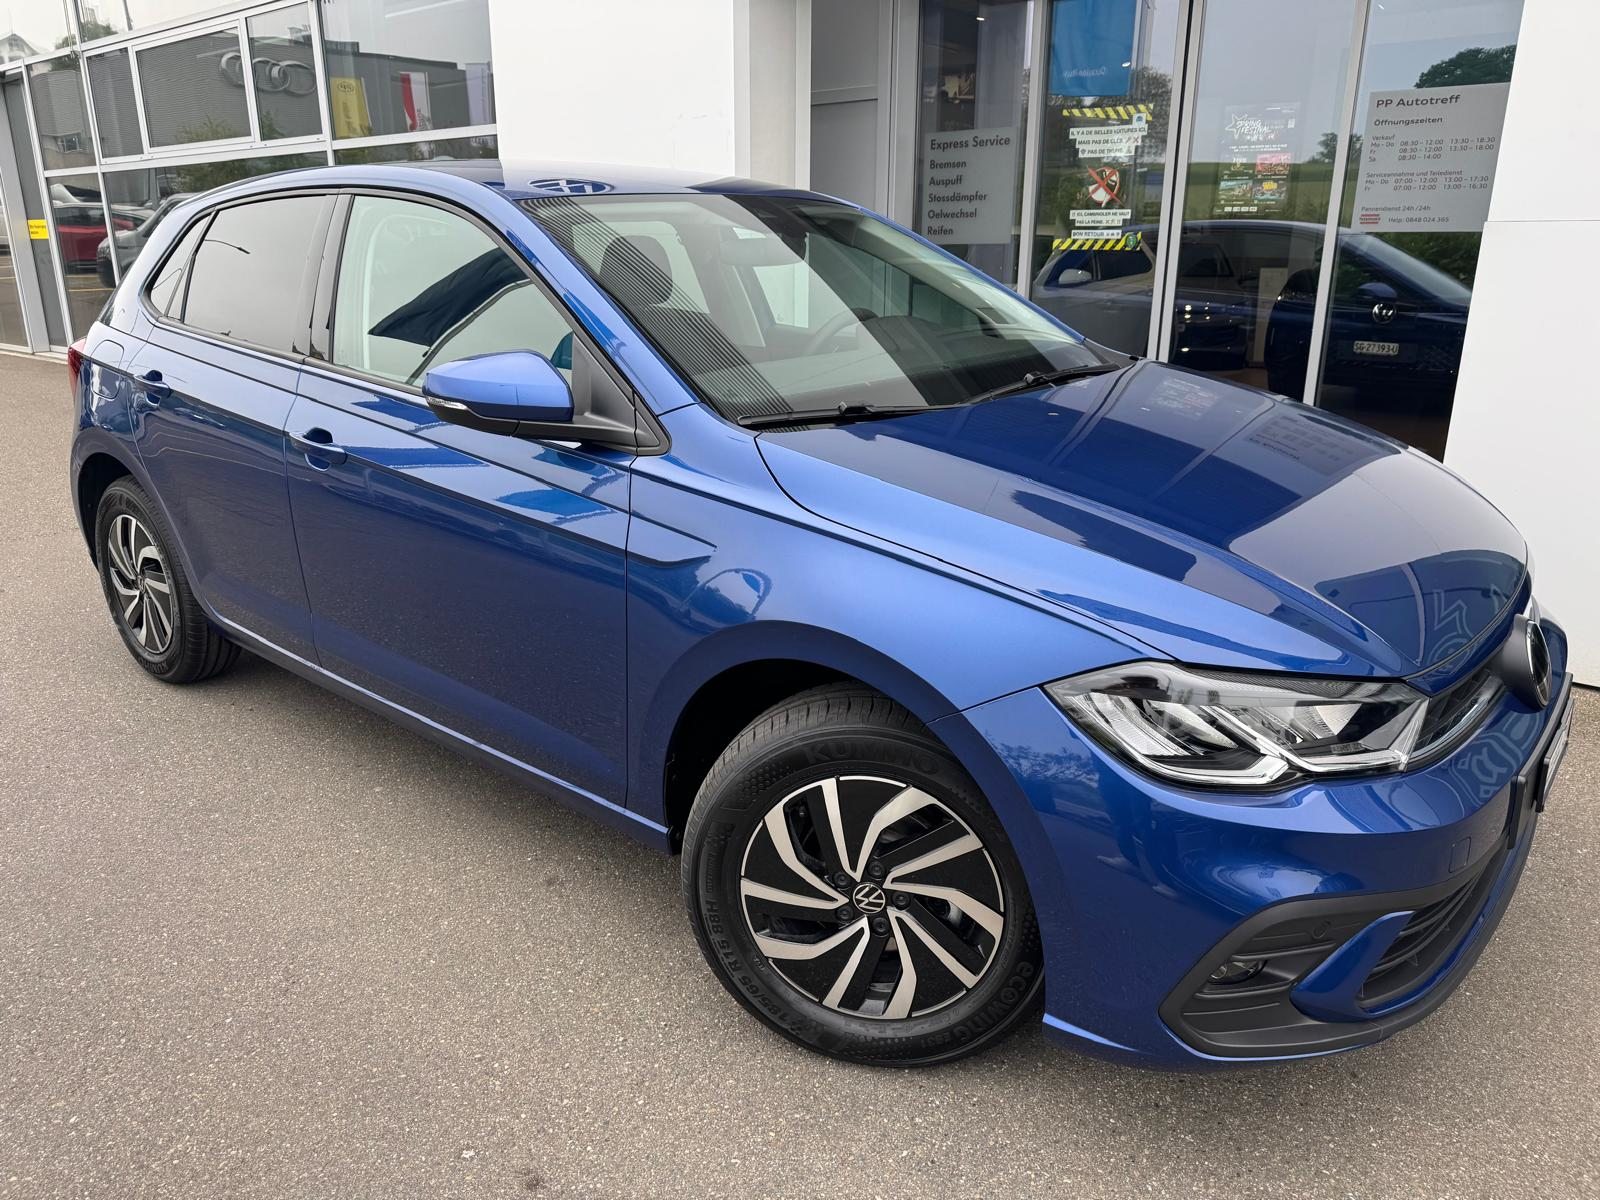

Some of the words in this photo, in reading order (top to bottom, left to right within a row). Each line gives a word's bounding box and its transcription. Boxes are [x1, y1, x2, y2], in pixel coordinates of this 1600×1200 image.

[1376, 99, 1393, 108] PP
[1396, 94, 1461, 108] Autotreff
[1374, 116, 1443, 126] Öffnungszeiten
[930, 138, 968, 152] Express
[972, 135, 1010, 147] Service
[930, 160, 967, 170] Bremsen
[928, 174, 963, 188] Auspuff
[928, 190, 988, 203] Stossdämpfer
[928, 208, 977, 220] Oelwechsel
[928, 226, 954, 236] Reifen
[706, 898, 724, 932] 88H
[717, 938, 744, 973] R15
